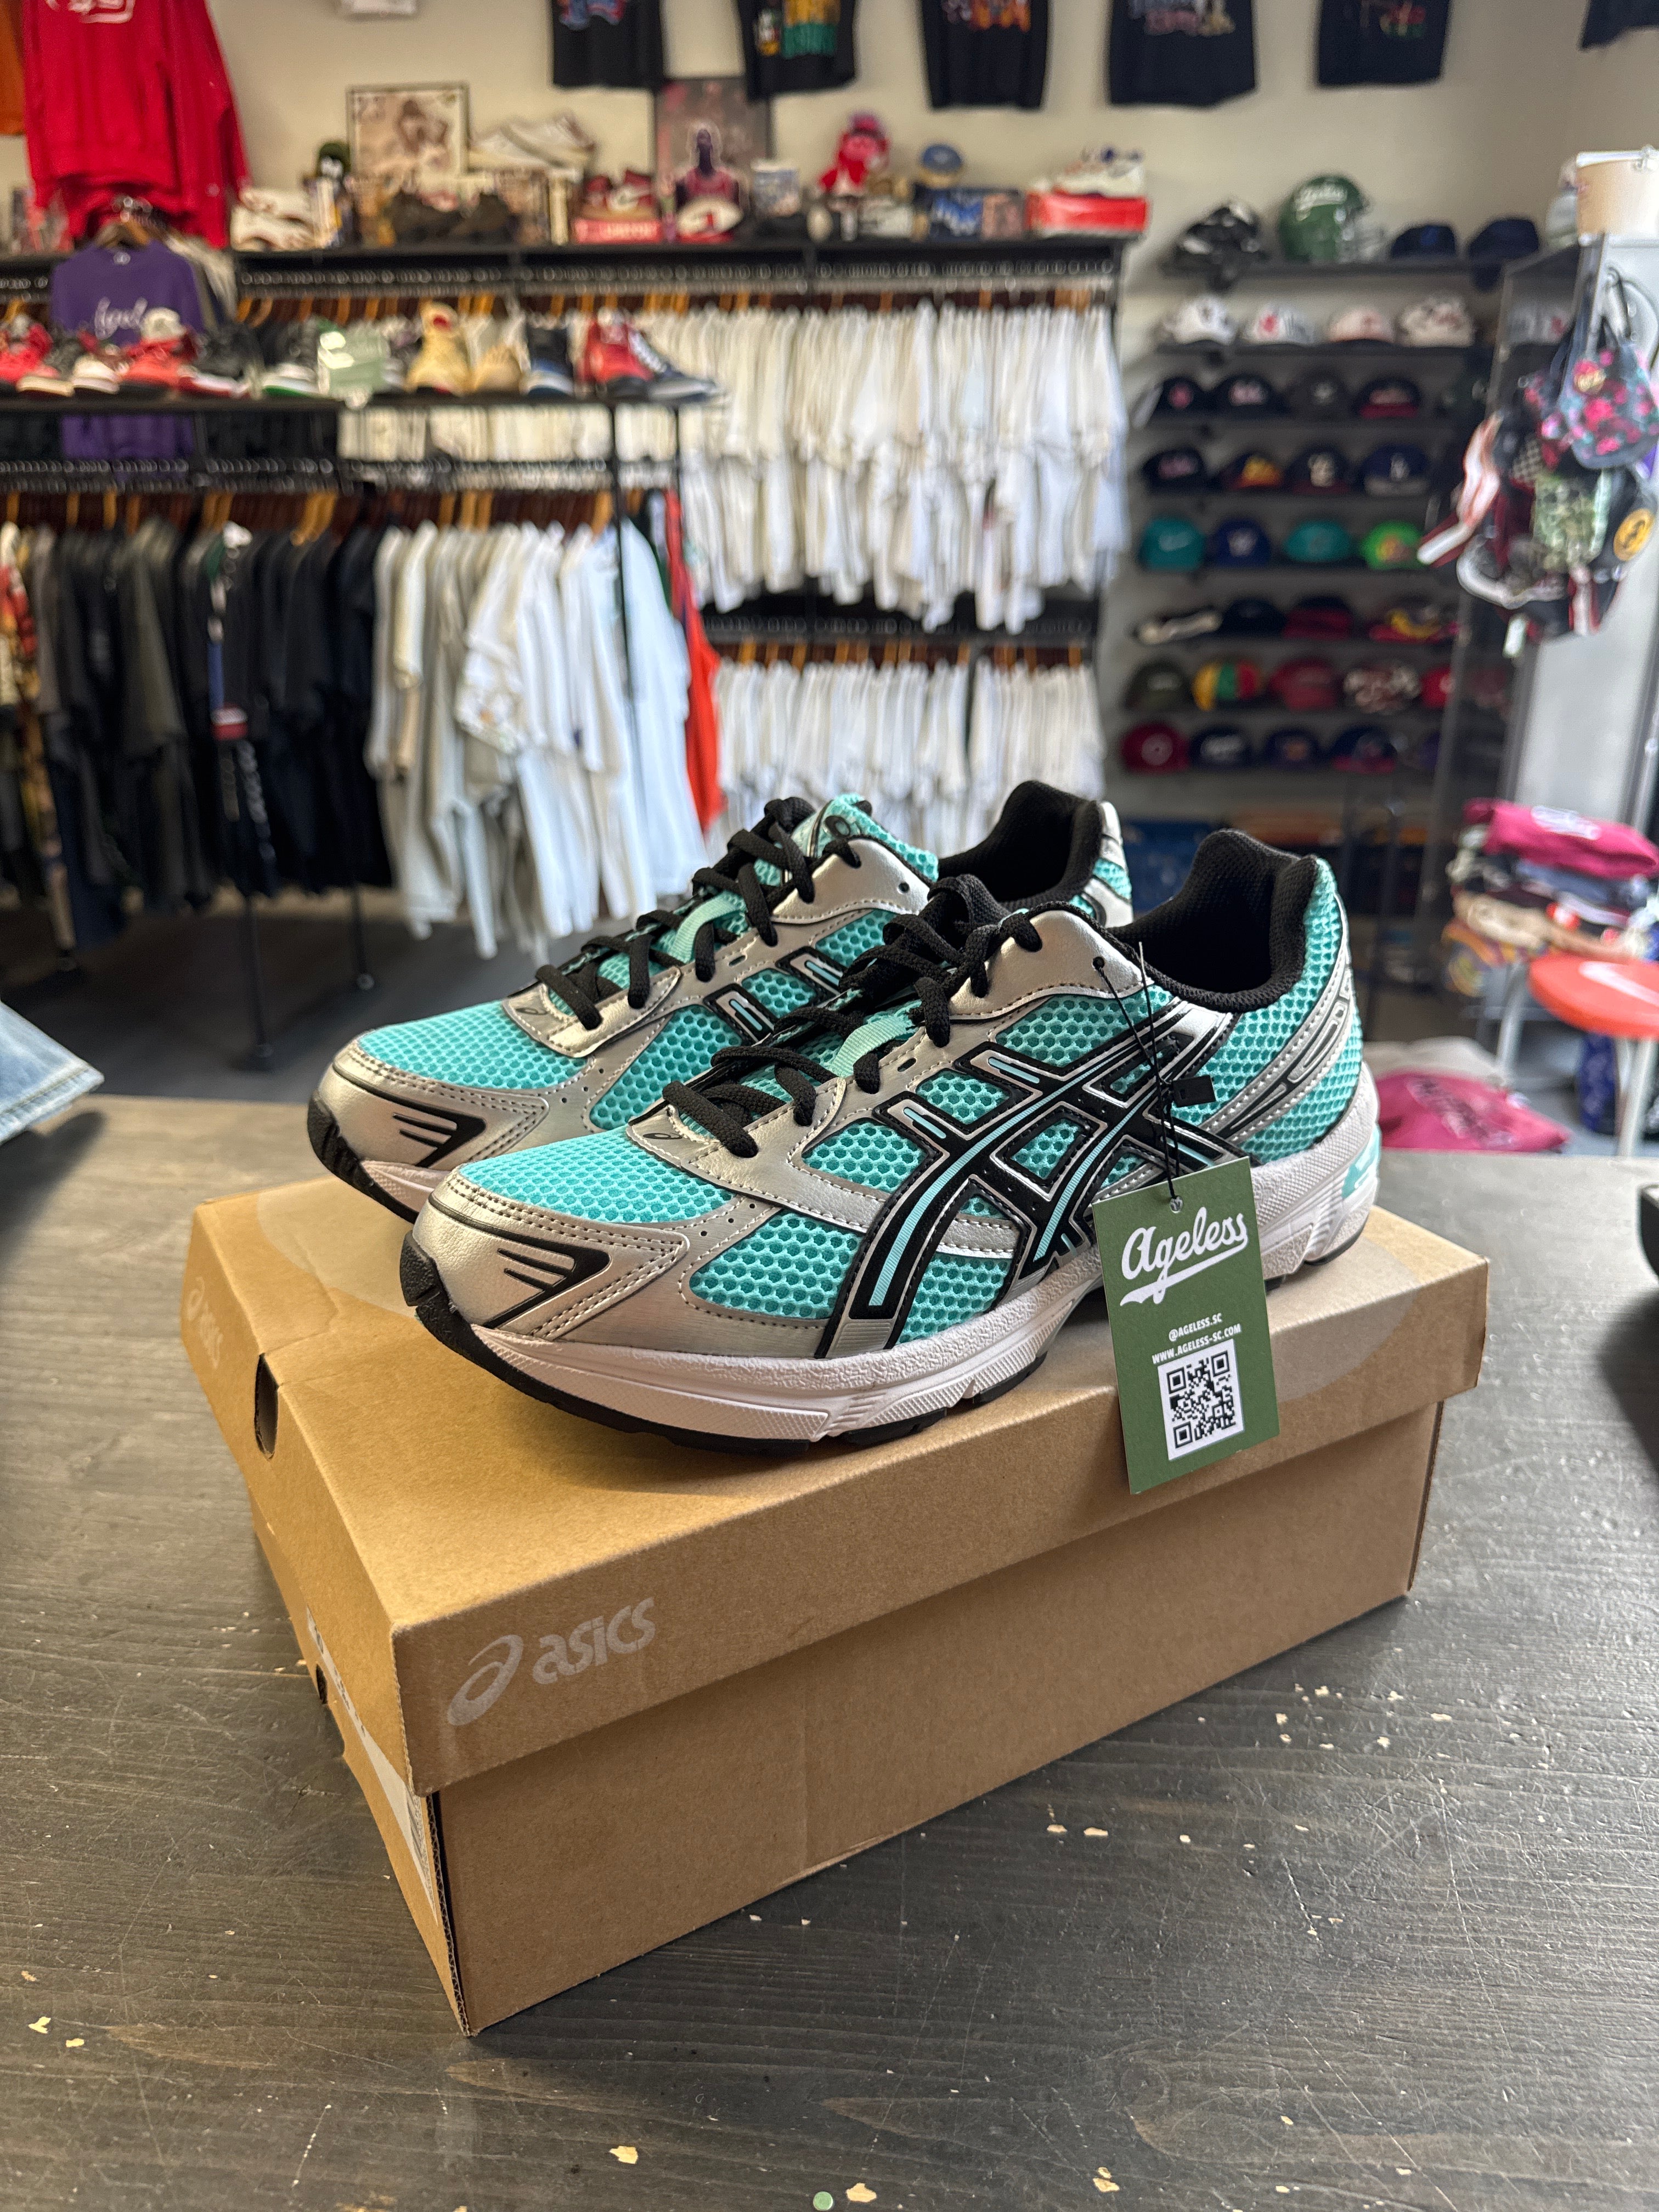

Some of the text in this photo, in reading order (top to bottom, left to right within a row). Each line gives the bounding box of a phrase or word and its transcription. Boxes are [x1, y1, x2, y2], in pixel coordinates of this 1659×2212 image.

[1120, 1206, 1248, 1306] Ageless
[1152, 1323, 1241, 1364] WWW.AGELESS-SC.COM
[1168, 1312, 1222, 1342] @AGELESS.SC
[532, 1596, 656, 1685] asics
